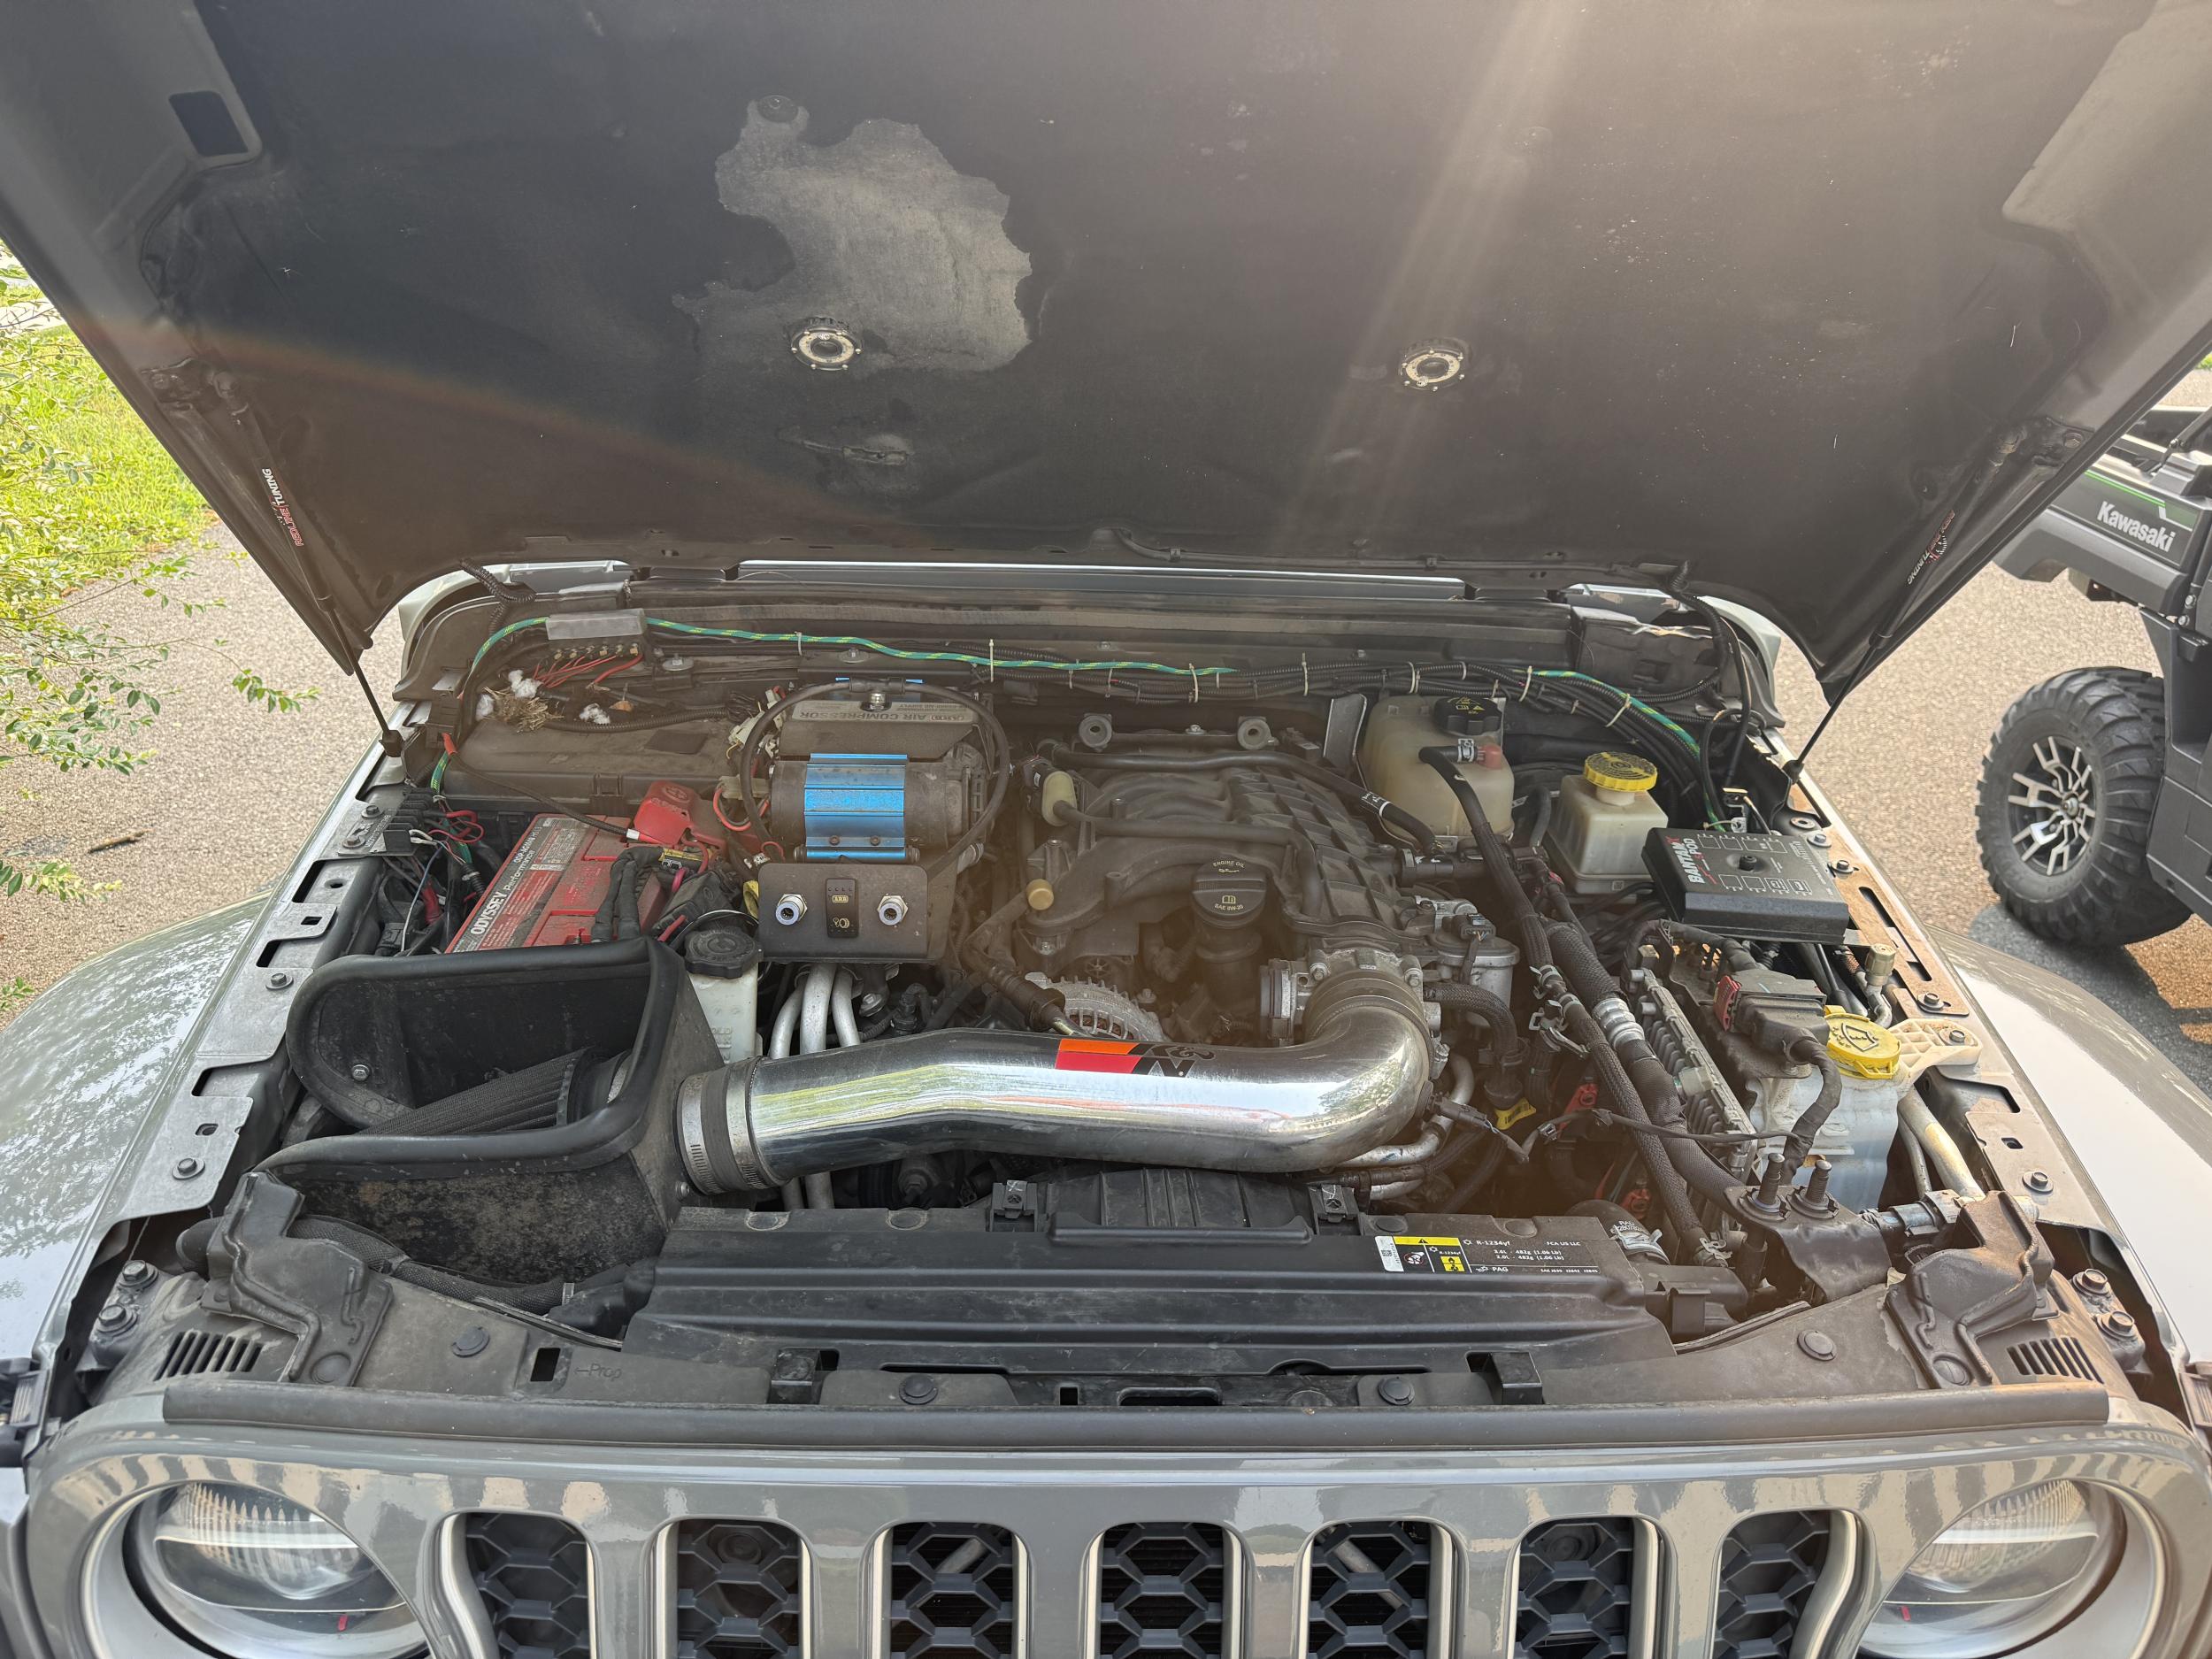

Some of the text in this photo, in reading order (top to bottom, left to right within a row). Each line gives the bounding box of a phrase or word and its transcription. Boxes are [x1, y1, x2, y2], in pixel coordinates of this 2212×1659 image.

[262, 468, 285, 505] TUNING
[2097, 500, 2176, 553] Kawasaki
[799, 710, 899, 720] COMPRESSOR
[470, 892, 507, 935] ODYSSEY
[503, 849, 535, 891] Performance
[1127, 1042, 1216, 1078] K&N
[588, 1363, 622, 1382] Prop
